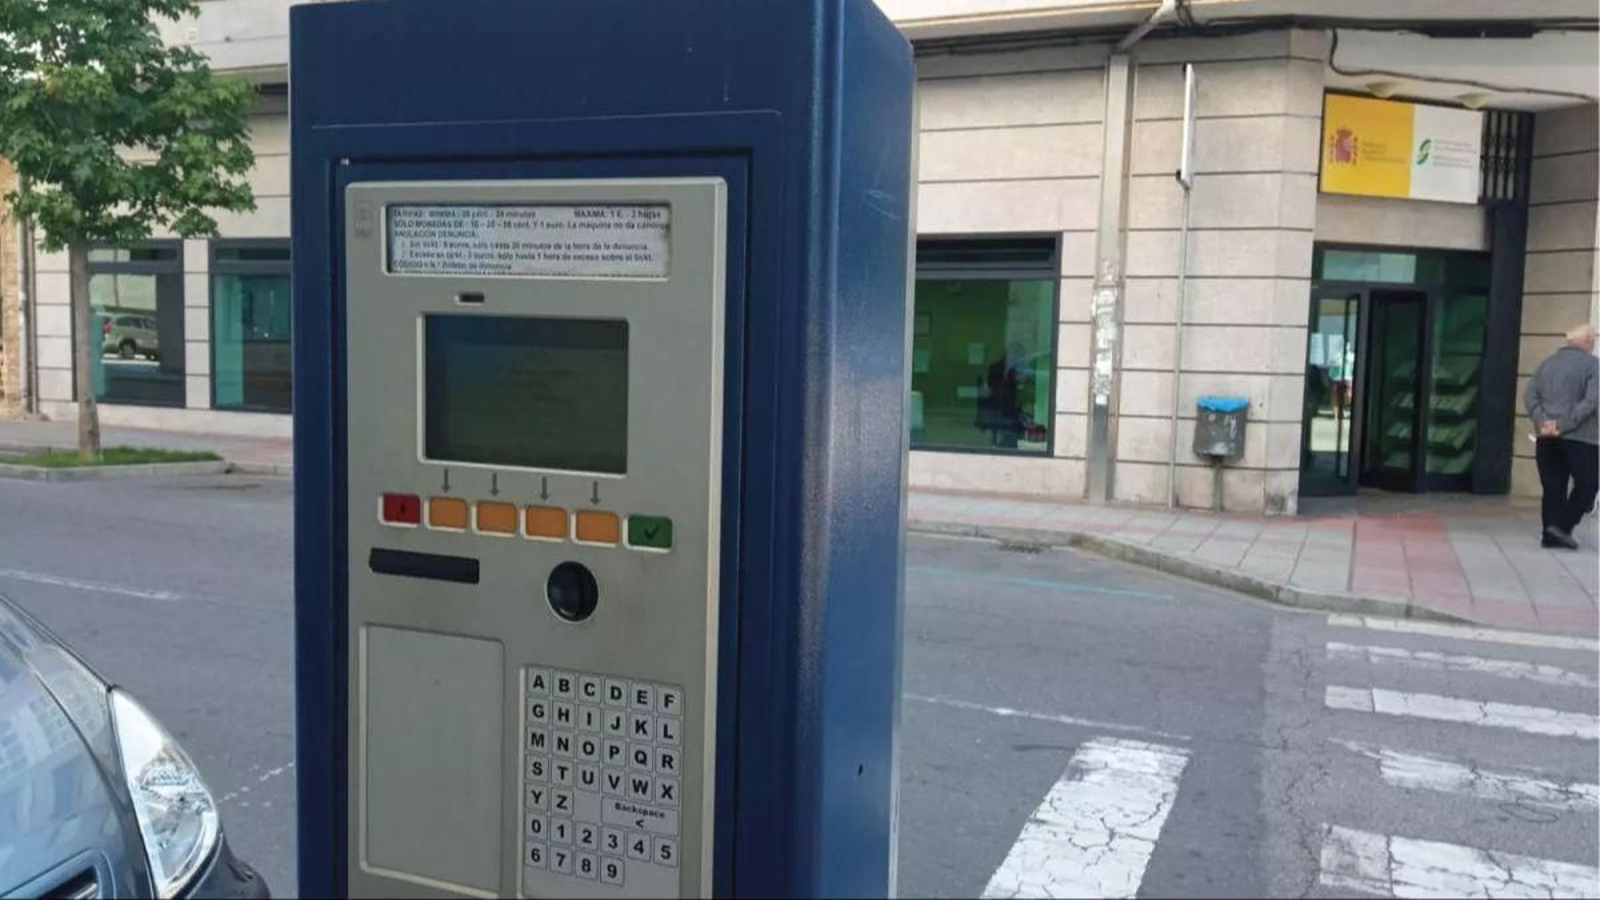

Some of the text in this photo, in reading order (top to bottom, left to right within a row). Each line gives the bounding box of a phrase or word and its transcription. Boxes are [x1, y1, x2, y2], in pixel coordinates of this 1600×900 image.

[533, 221, 538, 230] Y
[568, 221, 577, 230] La
[624, 222, 635, 230] da
[516, 252, 536, 260] hasta
[544, 252, 560, 261] hora
[562, 252, 571, 261] de
[572, 254, 600, 262] exceso
[600, 253, 624, 262] sobre
[626, 253, 632, 262] el
[522, 242, 552, 250] minutos
[553, 242, 562, 250] de
[572, 242, 590, 251] hora
[592, 242, 602, 251] de
[603, 242, 611, 251] la
[532, 674, 674, 709] A B C D E F
[532, 703, 674, 740] G H I J K L
[531, 732, 674, 770] M N O P Q R
[532, 761, 673, 800] S T U V W X
[531, 789, 568, 810] Y Z
[615, 802, 665, 819] Backspace
[531, 819, 671, 860] 0 1 2 3 4 5
[531, 847, 618, 879] 6 7 8 9
